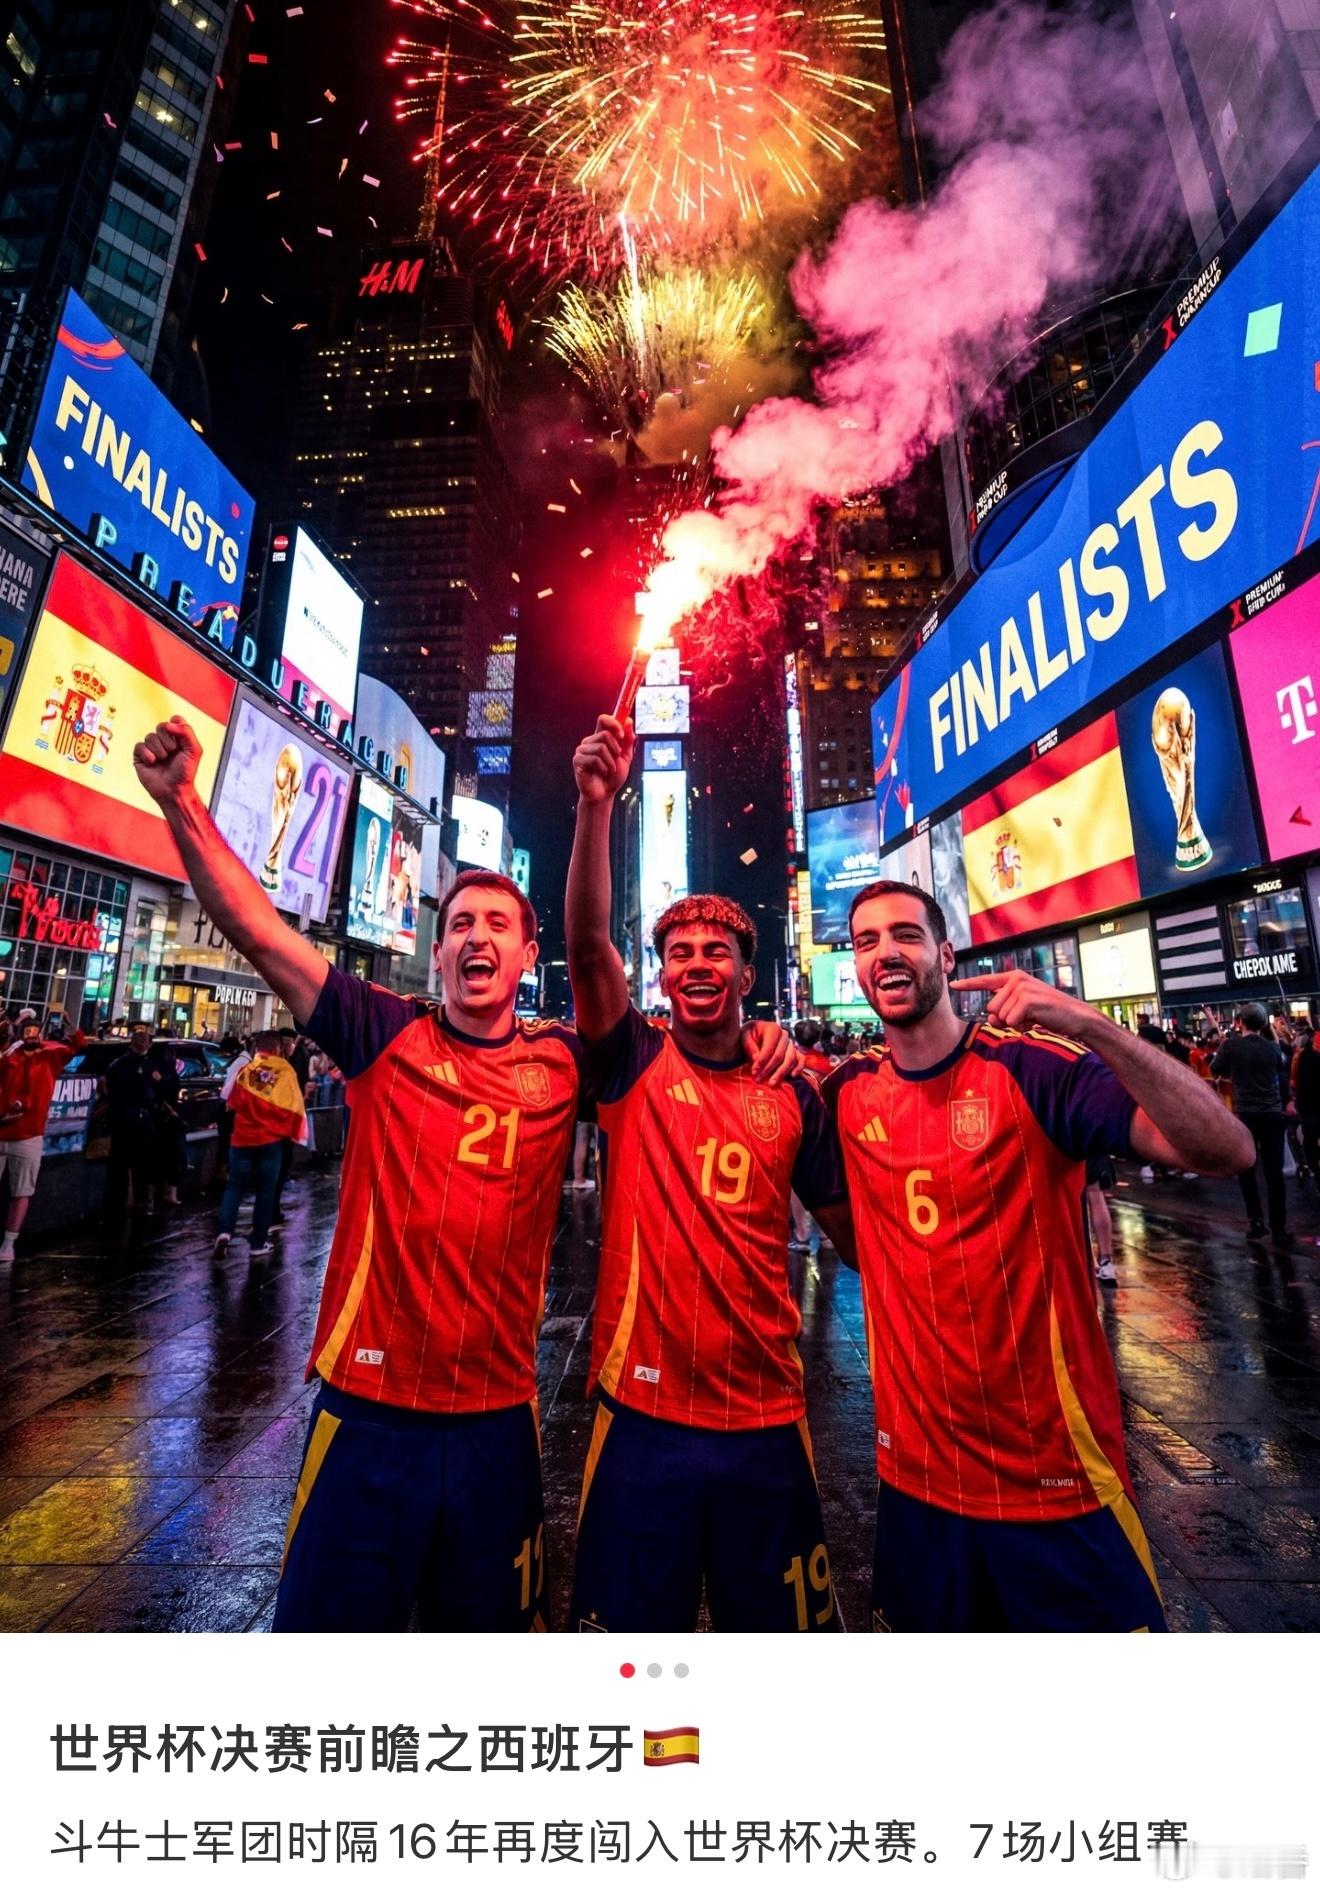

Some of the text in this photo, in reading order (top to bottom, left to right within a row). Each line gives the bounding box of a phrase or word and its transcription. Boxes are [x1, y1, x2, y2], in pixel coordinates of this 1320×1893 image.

[359, 258, 424, 297] H&M
[55, 375, 240, 585] FINALISTS
[0, 576, 28, 612] ERE
[928, 420, 1239, 775] FINALISTS
[457, 1103, 521, 1169] 21
[696, 1137, 751, 1204] 19
[905, 1169, 939, 1235] 6
[783, 1543, 832, 1631] 19
